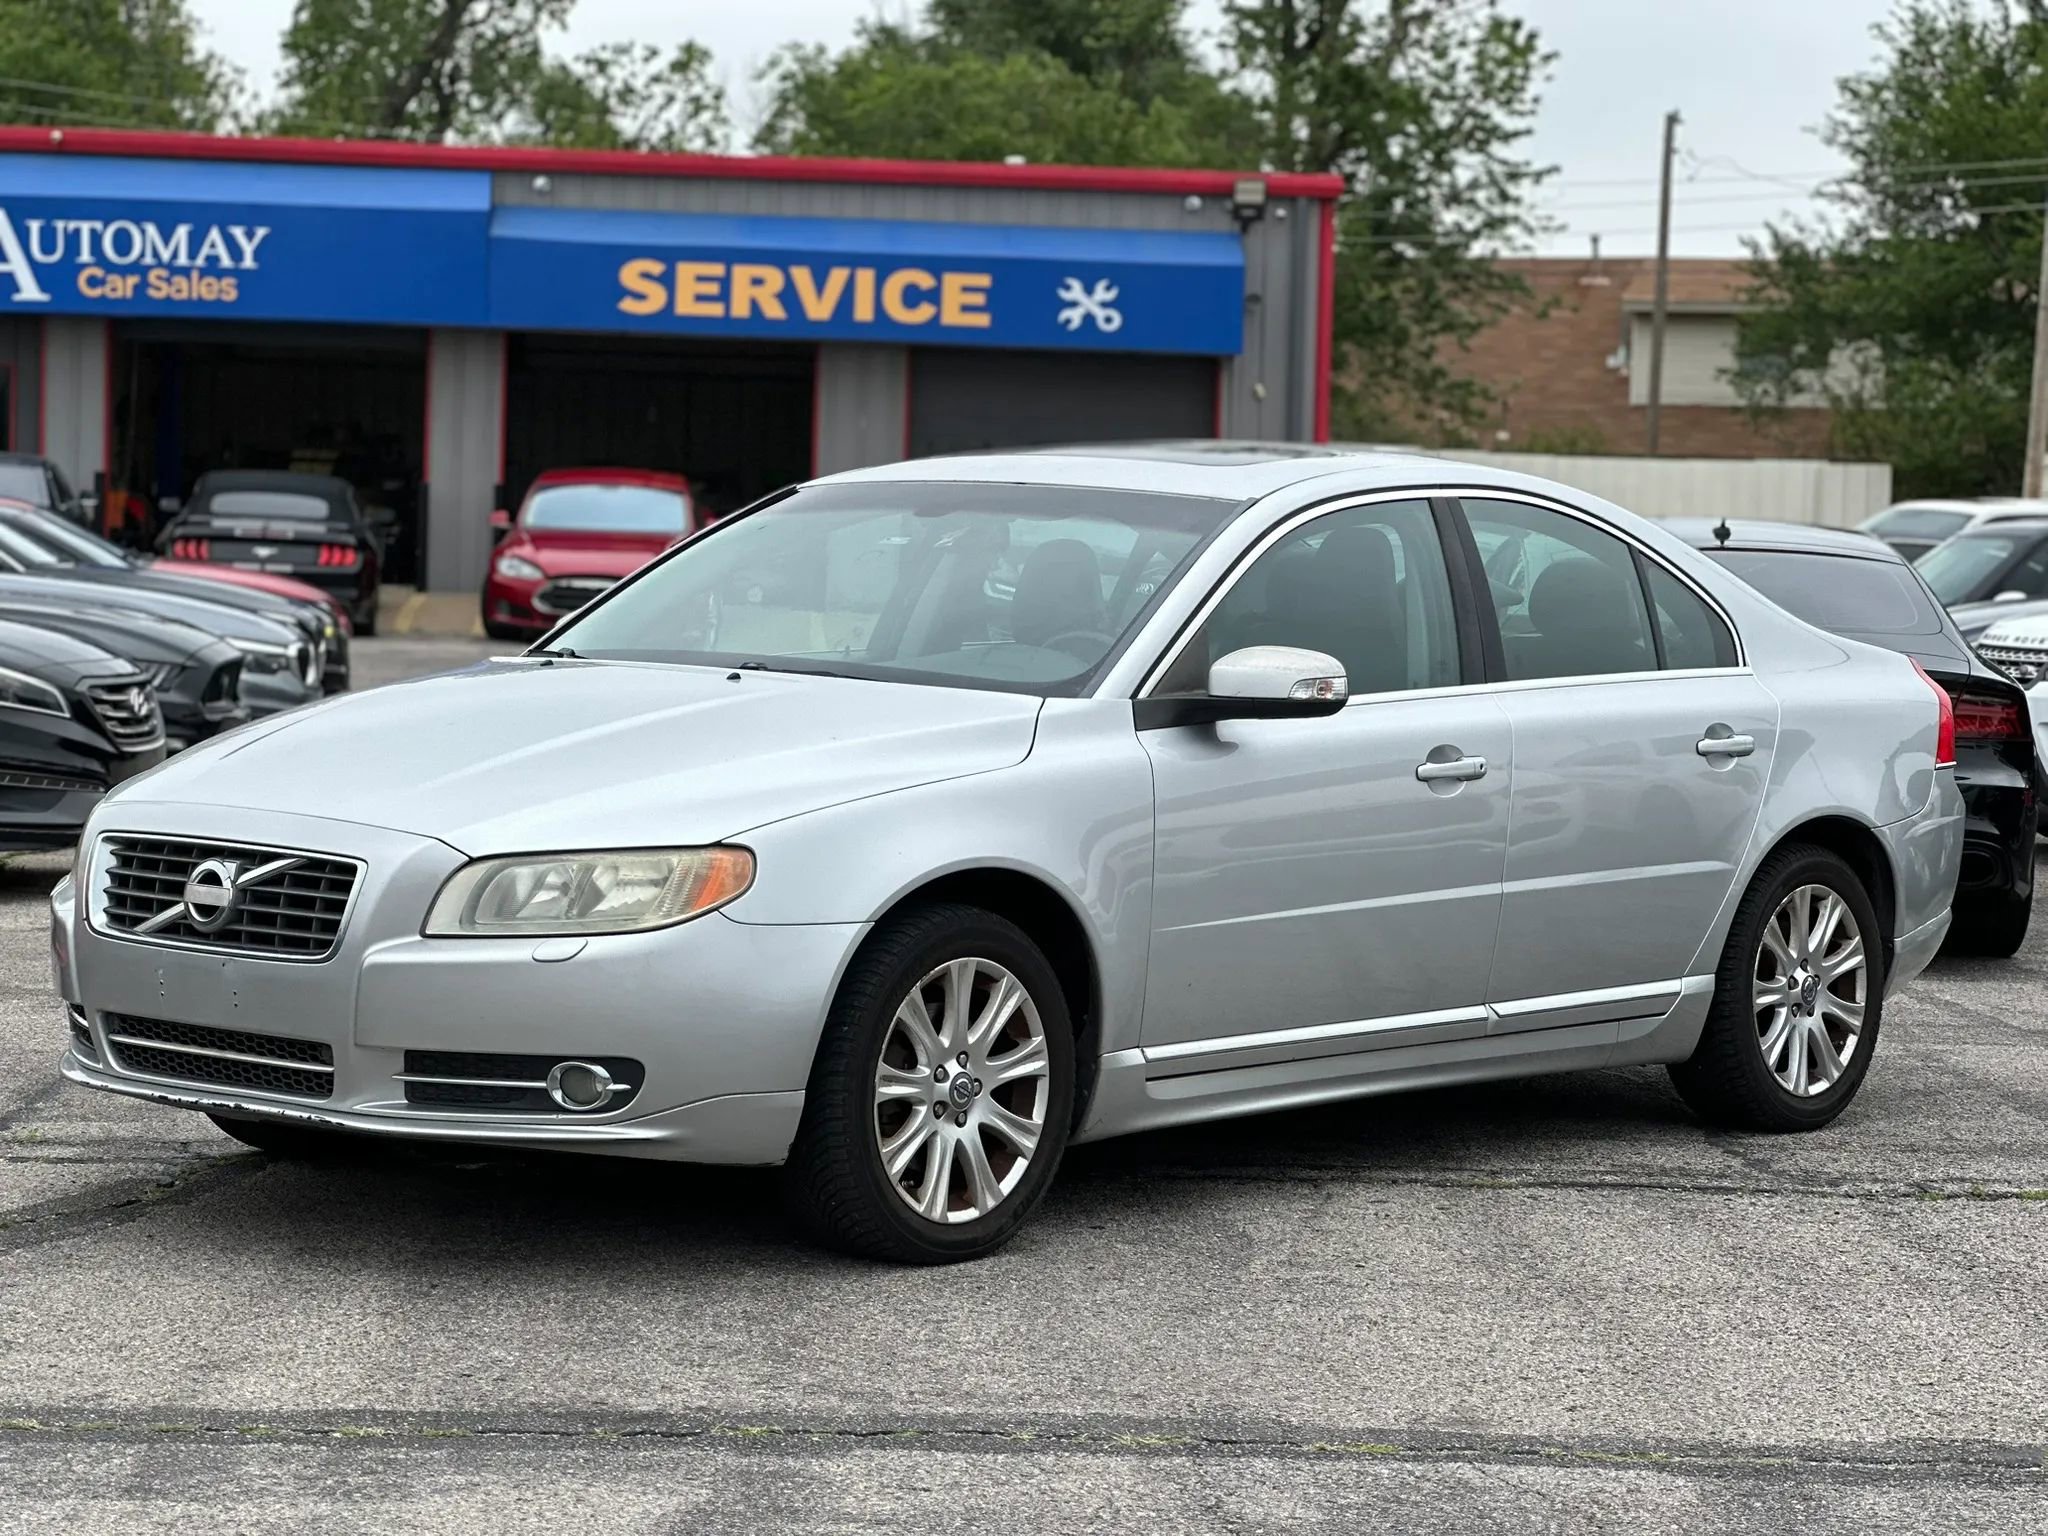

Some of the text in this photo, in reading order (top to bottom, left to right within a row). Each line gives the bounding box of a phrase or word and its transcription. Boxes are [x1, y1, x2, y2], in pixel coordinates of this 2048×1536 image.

[77, 266, 239, 302] Car Sales
[617, 258, 993, 328] SERVICE
